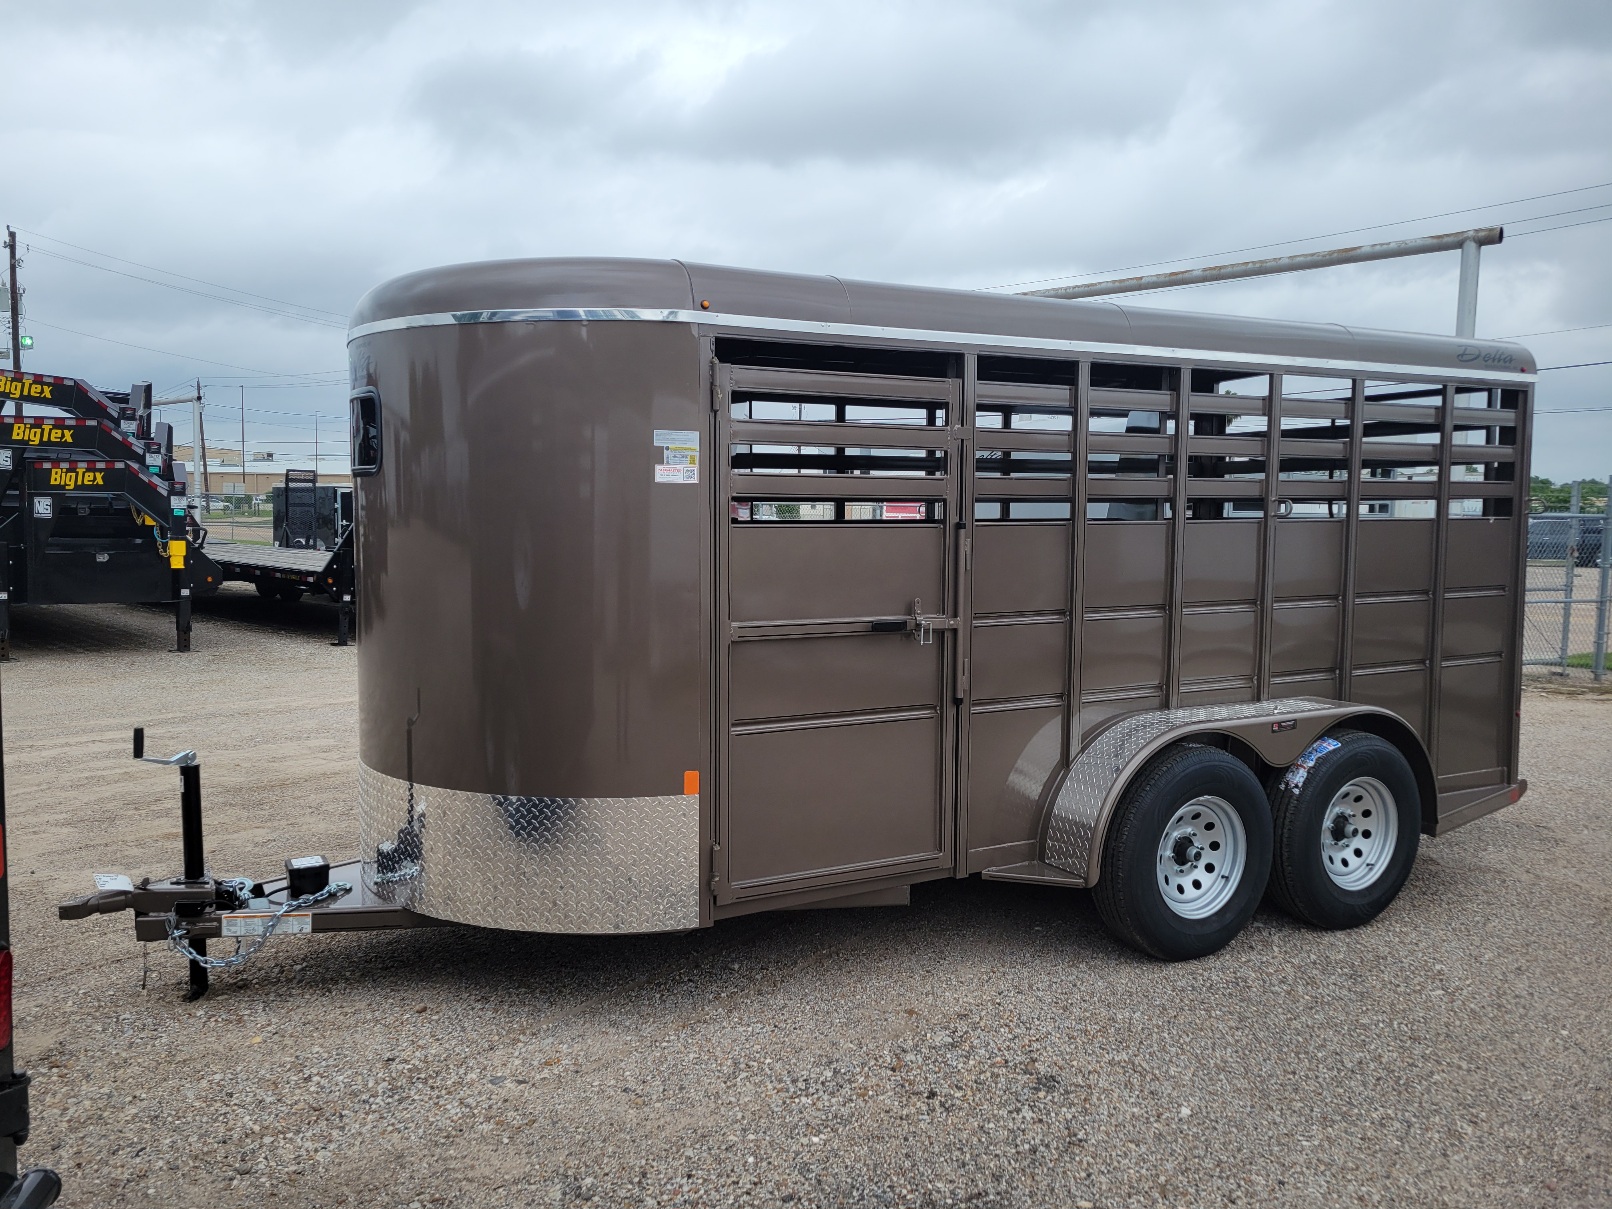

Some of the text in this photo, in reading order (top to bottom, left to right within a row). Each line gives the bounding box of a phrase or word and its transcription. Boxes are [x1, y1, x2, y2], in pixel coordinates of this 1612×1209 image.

[1456, 344, 1516, 364] Delta
[0, 376, 53, 398] BigTex
[12, 423, 74, 445] BigTex
[50, 468, 104, 489] BigTex
